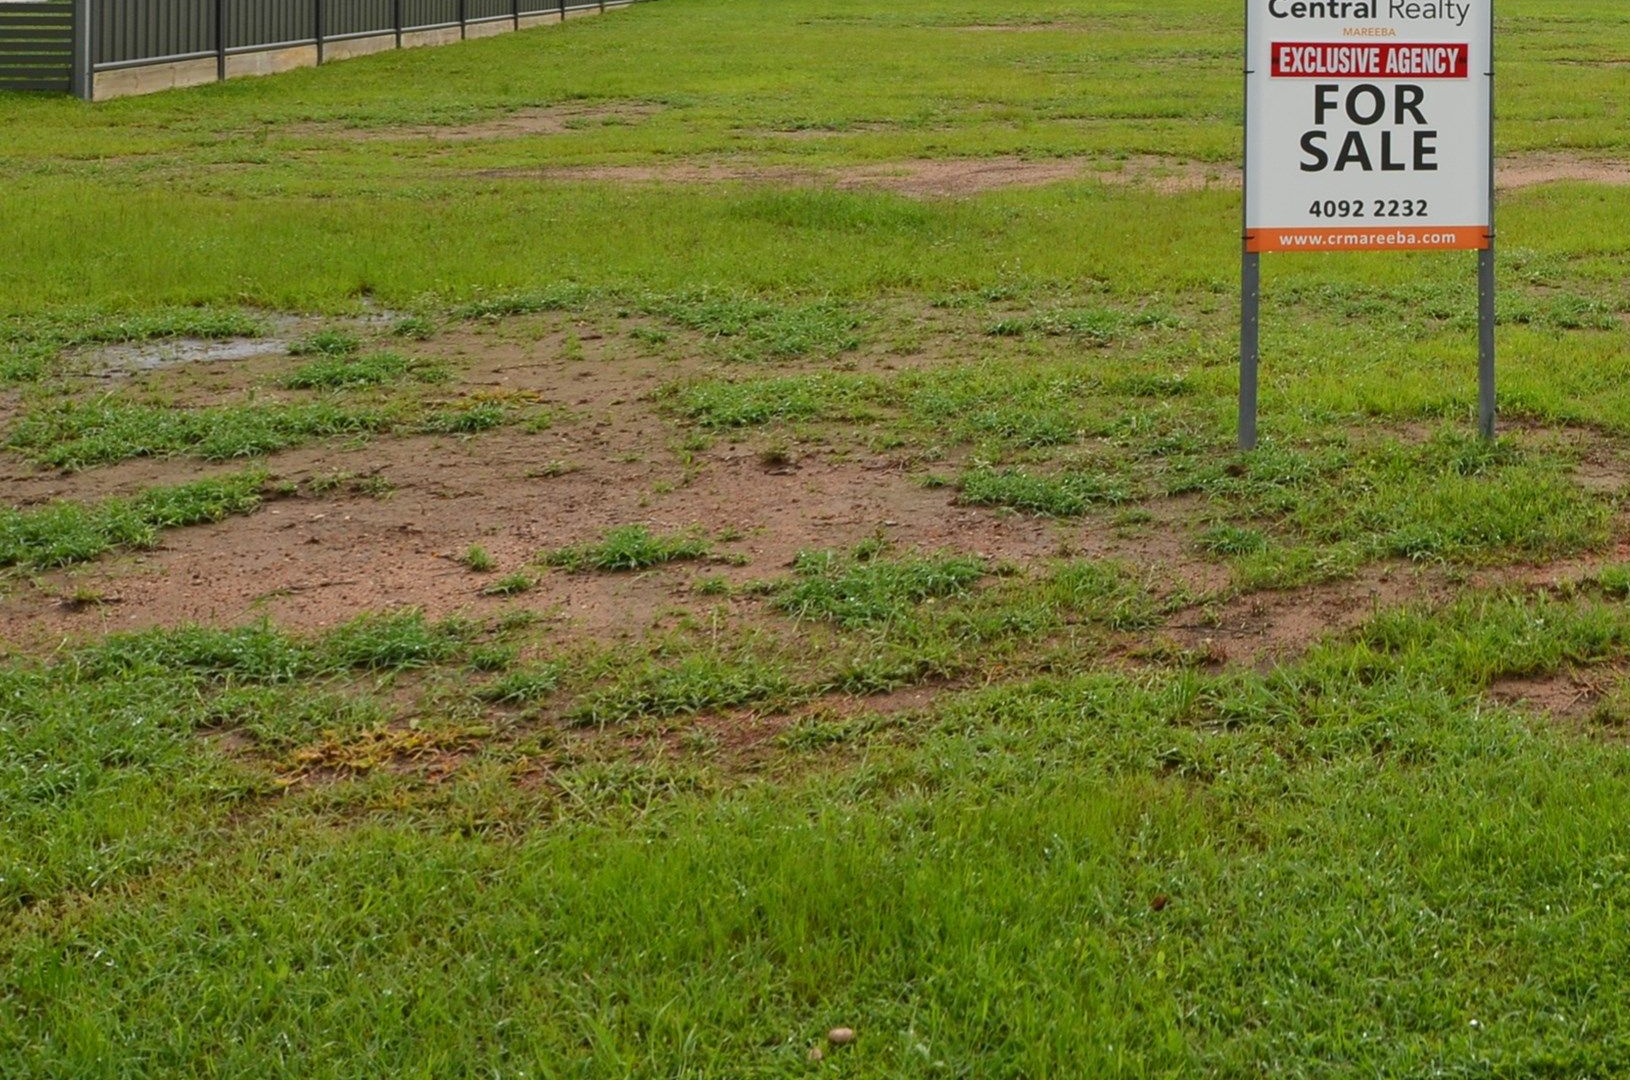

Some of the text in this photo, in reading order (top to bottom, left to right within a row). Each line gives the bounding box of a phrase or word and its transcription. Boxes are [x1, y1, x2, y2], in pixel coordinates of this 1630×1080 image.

[1343, 28, 1396, 37] MAREEBA
[1279, 47, 1460, 74] EXCLUSIVE AGENCY
[1314, 84, 1428, 125] FOR
[1300, 130, 1438, 172] SALE
[1309, 200, 1428, 217] 4092 2232
[1279, 231, 1456, 246] www.crmareeba.com
